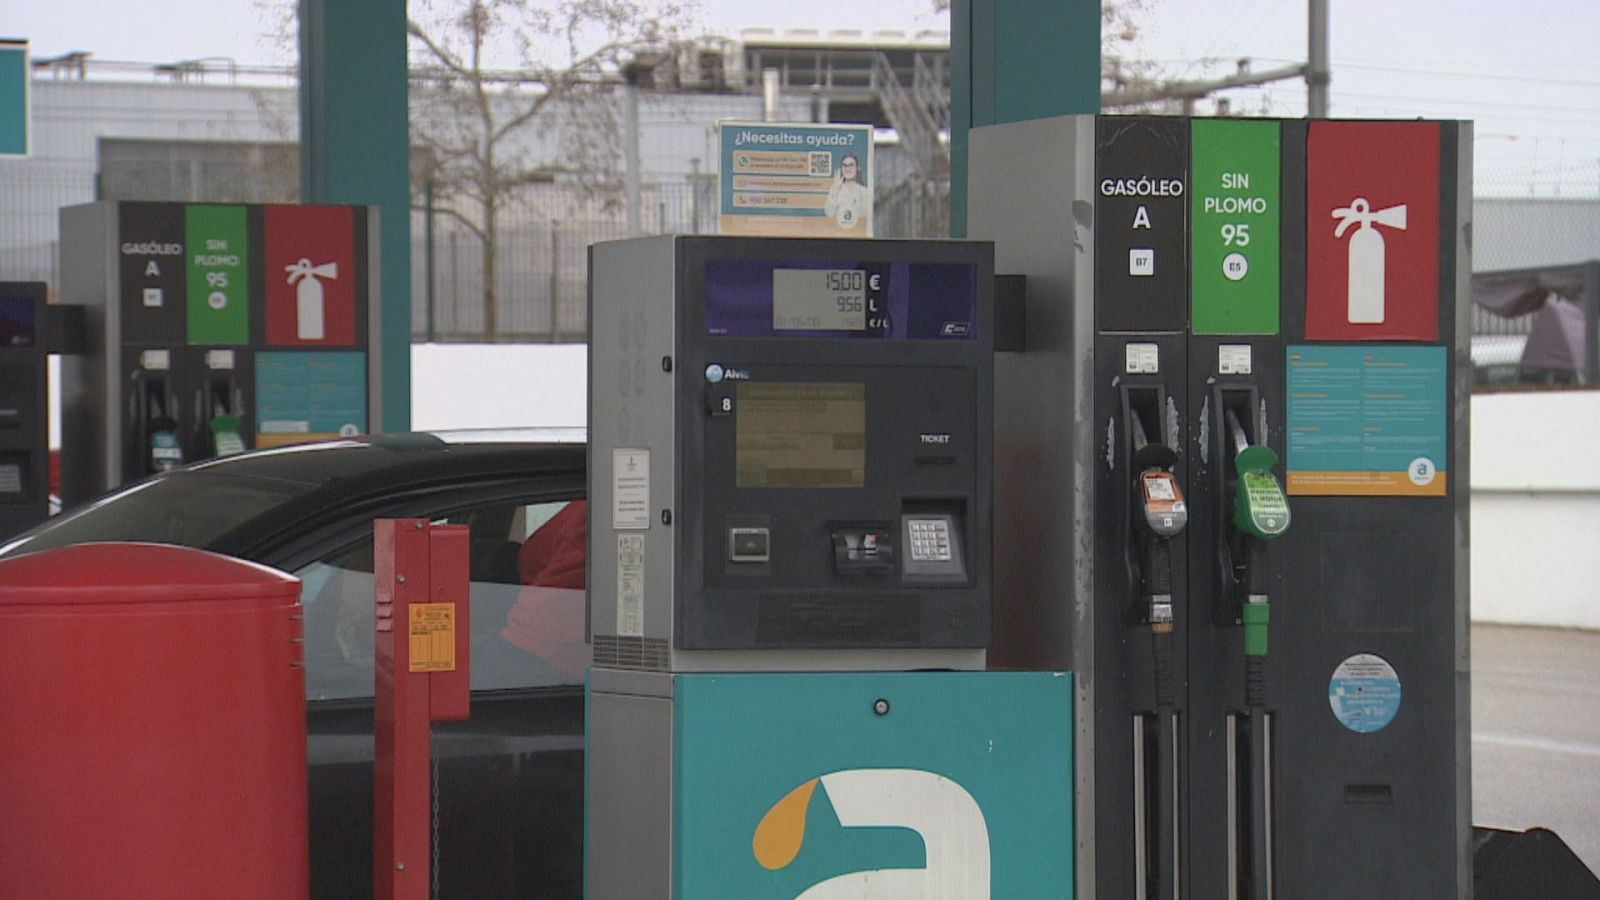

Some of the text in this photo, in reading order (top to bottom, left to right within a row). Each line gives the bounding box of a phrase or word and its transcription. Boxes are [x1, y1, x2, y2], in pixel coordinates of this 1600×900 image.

[735, 131, 855, 147] ¿Necesitas ayuda?
[1101, 176, 1183, 196] GASÓLEO
[1221, 173, 1249, 189] SIN
[1204, 198, 1267, 213] PLOMO
[1132, 206, 1151, 229] A
[1221, 224, 1250, 246] 95
[121, 240, 183, 255] GASÓLEO
[206, 239, 228, 250] SIN
[194, 255, 240, 266] PLOMO
[144, 261, 160, 276] A
[206, 272, 229, 288] 95
[869, 274, 881, 291] €
[722, 398, 731, 411] 8
[920, 434, 950, 443] TICKET
